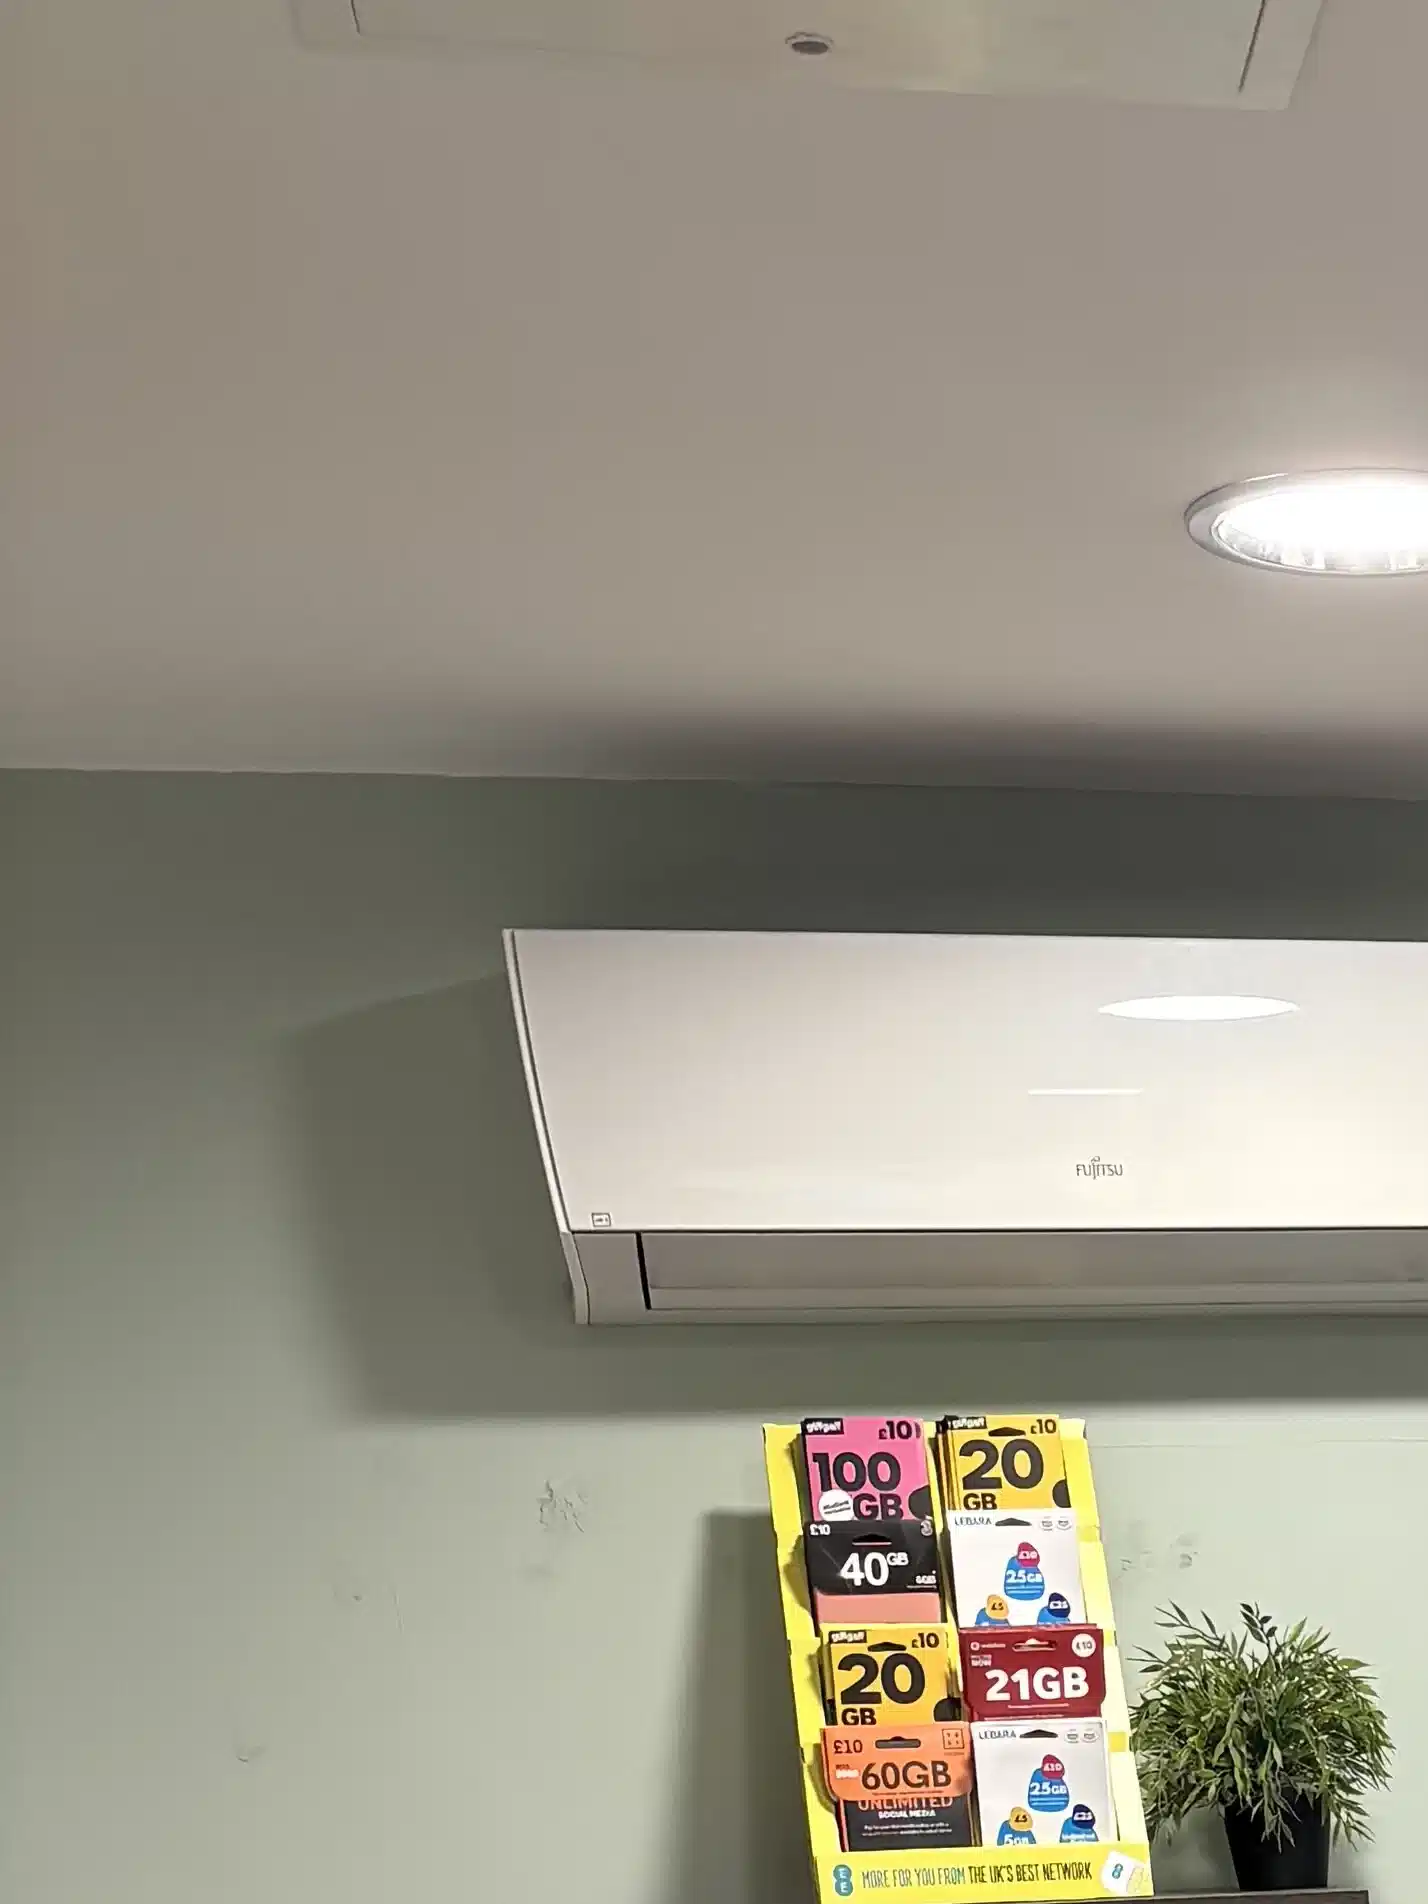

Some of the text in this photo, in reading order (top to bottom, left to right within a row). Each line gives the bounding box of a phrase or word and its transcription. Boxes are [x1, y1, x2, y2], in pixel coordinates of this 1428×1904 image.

[1075, 1155, 1124, 1181] FUJITSU
[1030, 1419, 1057, 1435] £10
[812, 1452, 901, 1492] 100
[959, 1438, 1044, 1490] 20
[852, 1493, 904, 1521] GB
[963, 1492, 998, 1511] GB
[809, 1524, 831, 1536] £10
[911, 1632, 940, 1649] £10
[838, 1653, 925, 1705] 20
[985, 1666, 1090, 1701] 21GB
[841, 1707, 877, 1726] GB
[978, 1729, 1017, 1740] LEBARA
[833, 1739, 863, 1754] £10
[861, 1760, 952, 1790] 60GB
[857, 1796, 953, 1812] UNLIMITED
[862, 1861, 1093, 1888] MORE FOR YOU FROM THE UK'S BEST NETWORK
